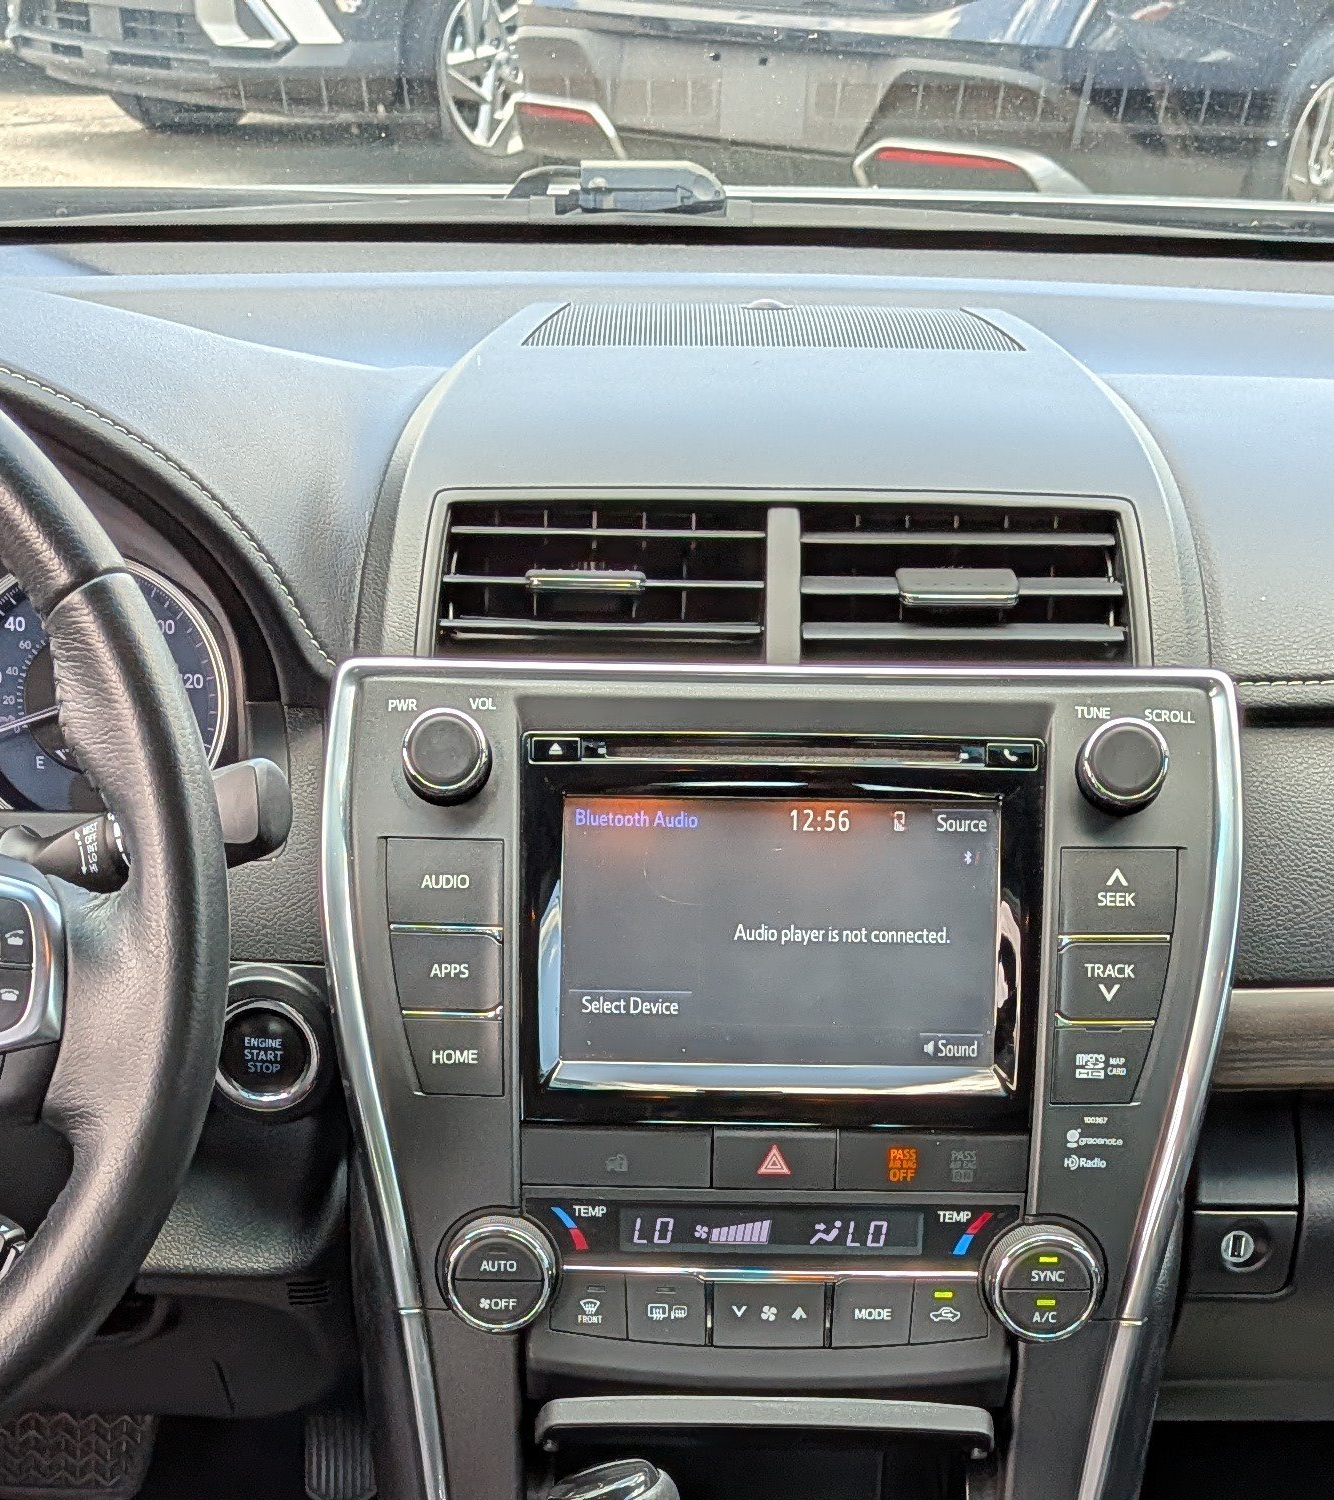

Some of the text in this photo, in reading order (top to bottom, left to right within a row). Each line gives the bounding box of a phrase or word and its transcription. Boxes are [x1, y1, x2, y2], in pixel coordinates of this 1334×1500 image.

[4, 616, 26, 632] 40
[158, 619, 175, 635] 00
[19, 640, 32, 650] 60
[5, 666, 19, 676] 40
[182, 673, 204, 689] 20
[2, 695, 16, 705] 20
[388, 698, 418, 712] PWR
[469, 697, 497, 710] VOL
[1074, 705, 1111, 719] TUNE
[1144, 708, 1196, 724] SCROLL
[35, 756, 45, 770] E
[574, 808, 699, 828] Bluetooth Audio
[789, 809, 851, 832] 12:56
[936, 814, 988, 833] Source
[420, 874, 470, 889] AUDIO
[1097, 892, 1136, 907] SEEK
[733, 923, 951, 946] Audio player is not connected.
[429, 963, 469, 978] APPS
[1084, 963, 1136, 978] TRACK
[581, 995, 679, 1015] Select Device
[244, 1036, 283, 1049] ENGINE
[937, 1040, 978, 1058] Sound
[243, 1049, 284, 1062] START
[431, 1049, 479, 1065] HOME
[1108, 1057, 1126, 1066] MAP
[247, 1062, 282, 1074] STOP
[1107, 1066, 1127, 1076] CARD
[889, 1148, 917, 1160] PASS
[1079, 1157, 1107, 1169] Radio
[889, 1168, 916, 1182] OFF
[572, 1205, 607, 1218] TEMP
[937, 1210, 972, 1223] TEMP
[480, 1260, 517, 1273] AUTO
[1030, 1270, 1066, 1283] SYNC
[490, 1298, 517, 1311] OFF
[577, 1315, 603, 1324] FRONT
[854, 1308, 892, 1321] MODE
[1032, 1311, 1057, 1324] A/C
